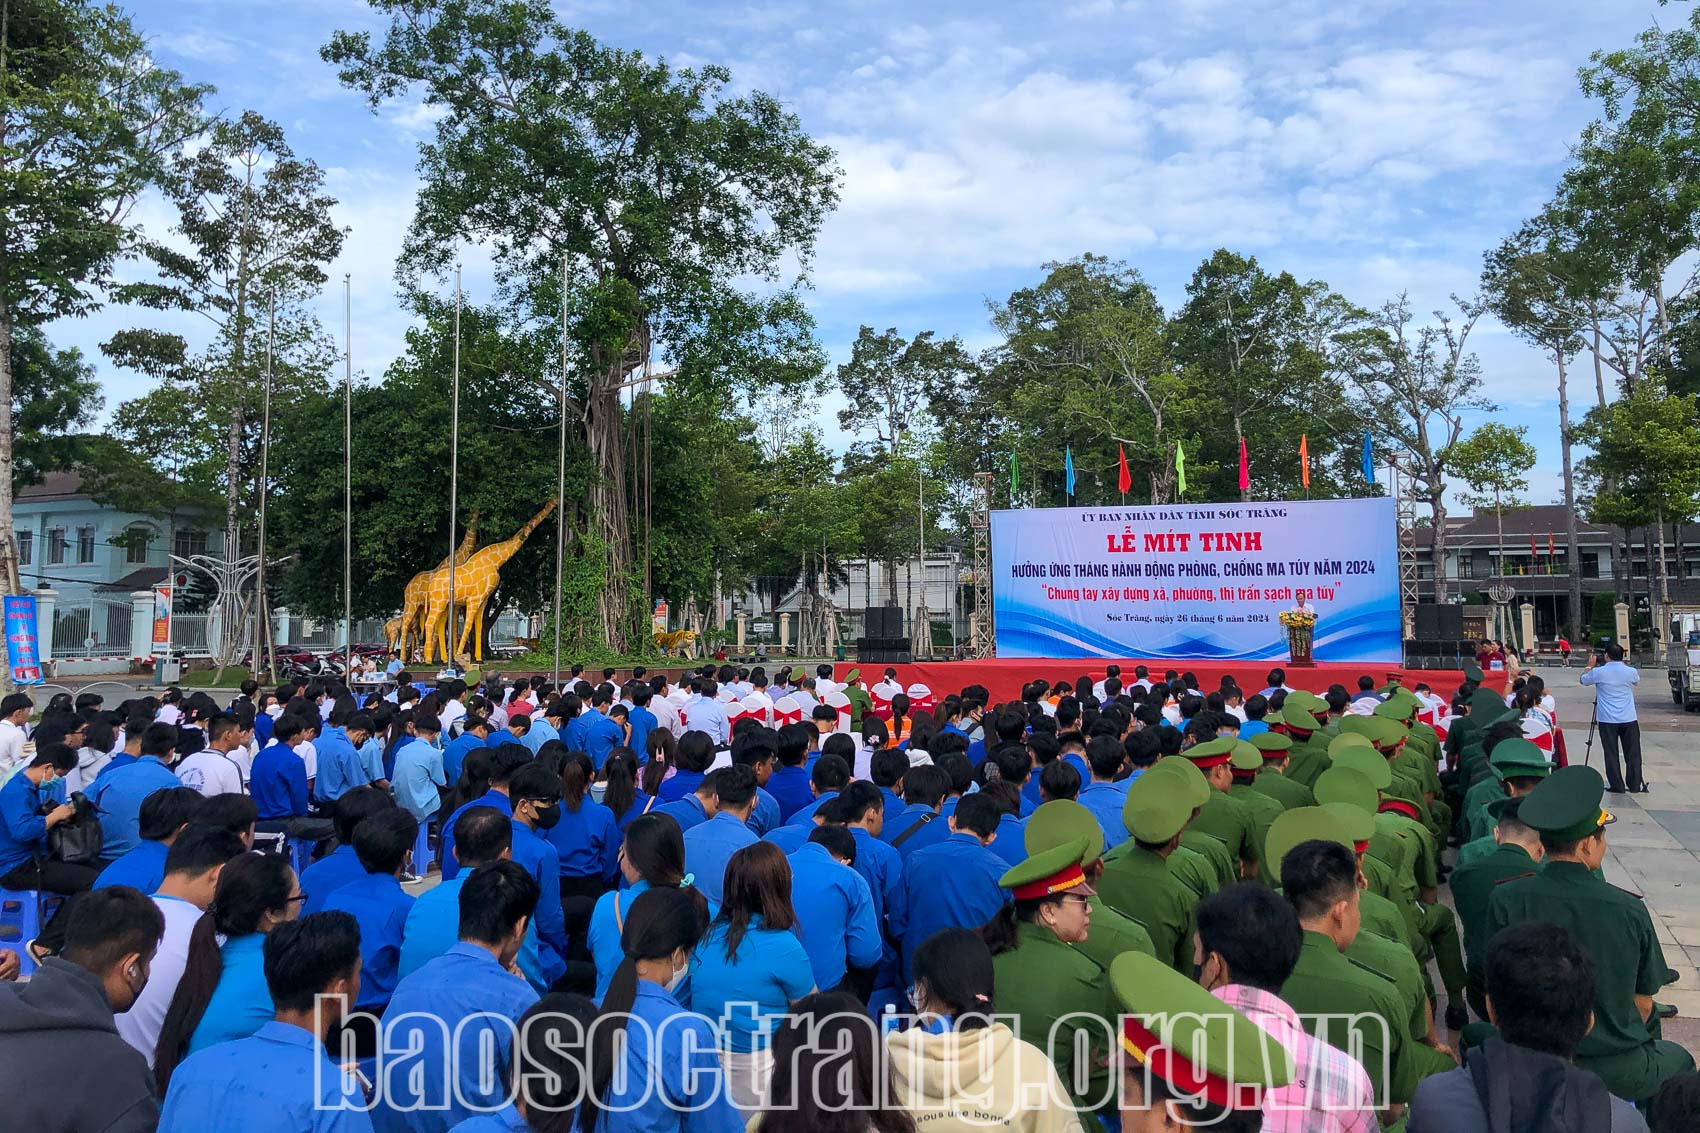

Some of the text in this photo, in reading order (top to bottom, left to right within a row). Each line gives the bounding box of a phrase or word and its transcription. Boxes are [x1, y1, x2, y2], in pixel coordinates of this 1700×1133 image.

[1099, 513, 1122, 522] BAN
[1124, 511, 1156, 521] NHÂN
[1159, 510, 1183, 521] DÂN
[1219, 509, 1242, 519] SÓC
[1246, 508, 1287, 519] TRĂNG
[1107, 526, 1262, 552] LỄ MÍT TINH
[1012, 558, 1375, 580] HƯỞNG ỨNG THÁNG HÀNH ĐỘNG PHÒNG, CHỐNG MA TÚY NĂM 2024
[1083, 587, 1098, 601] tay
[1102, 587, 1119, 601] xây
[1124, 587, 1149, 603] dựng
[1153, 587, 1169, 601] xã,
[1173, 586, 1216, 602] phường,
[1220, 587, 1235, 603] thị
[1238, 584, 1260, 600] trấn
[1264, 587, 1292, 603] sạch
[1106, 613, 1122, 622] Sóc
[1155, 614, 1175, 624] ngày
[1176, 614, 1188, 622] 26
[1191, 614, 1215, 624] tháng
[1217, 614, 1223, 623] 6
[1226, 614, 1245, 623] năm
[1247, 614, 1270, 623] 2024
[916, 1111, 944, 1123] sous
